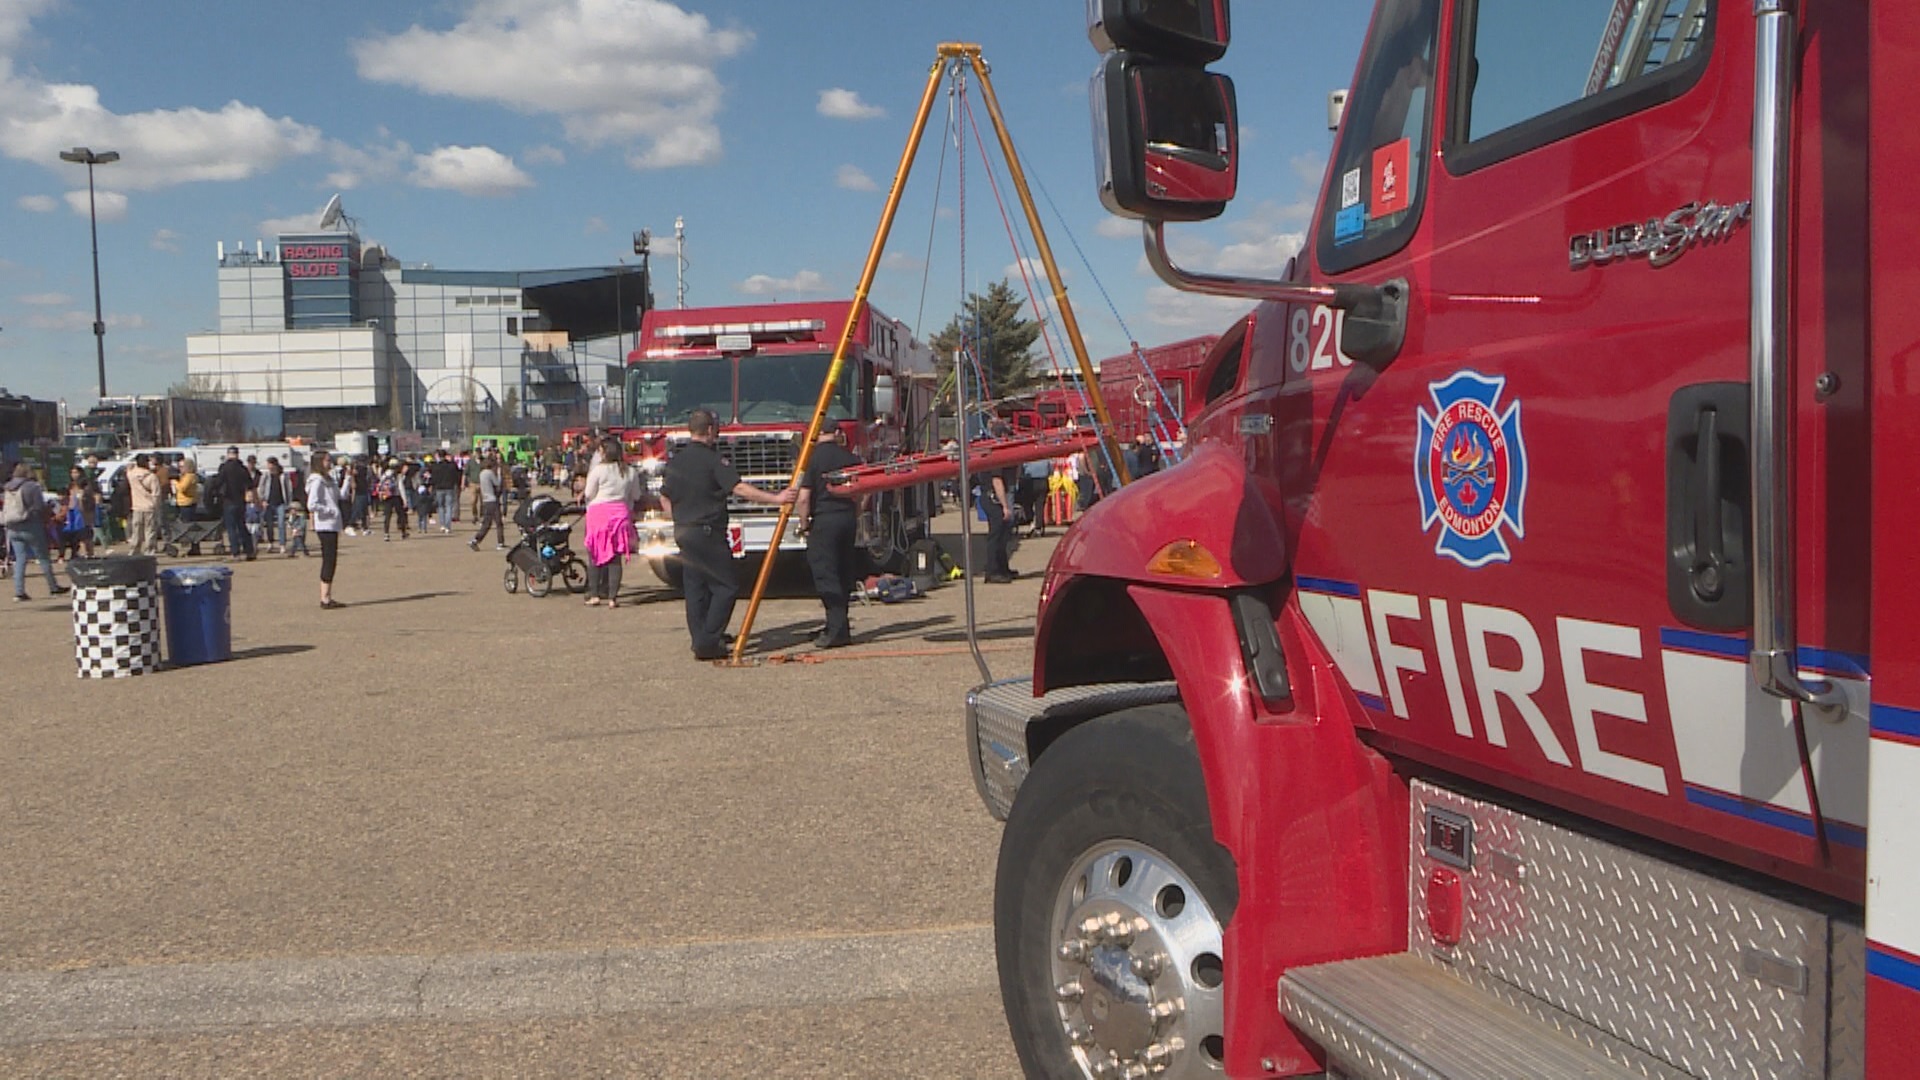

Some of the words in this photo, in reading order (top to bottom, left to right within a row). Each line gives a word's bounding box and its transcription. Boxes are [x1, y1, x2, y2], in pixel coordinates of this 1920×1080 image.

[284, 245, 342, 258] RACING
[291, 263, 337, 276] SLOTS
[1432, 413, 1453, 452] FIRE
[1459, 403, 1504, 451] RESCUE
[1438, 496, 1501, 535] EDMONTON
[1367, 589, 1669, 795] FIRE
